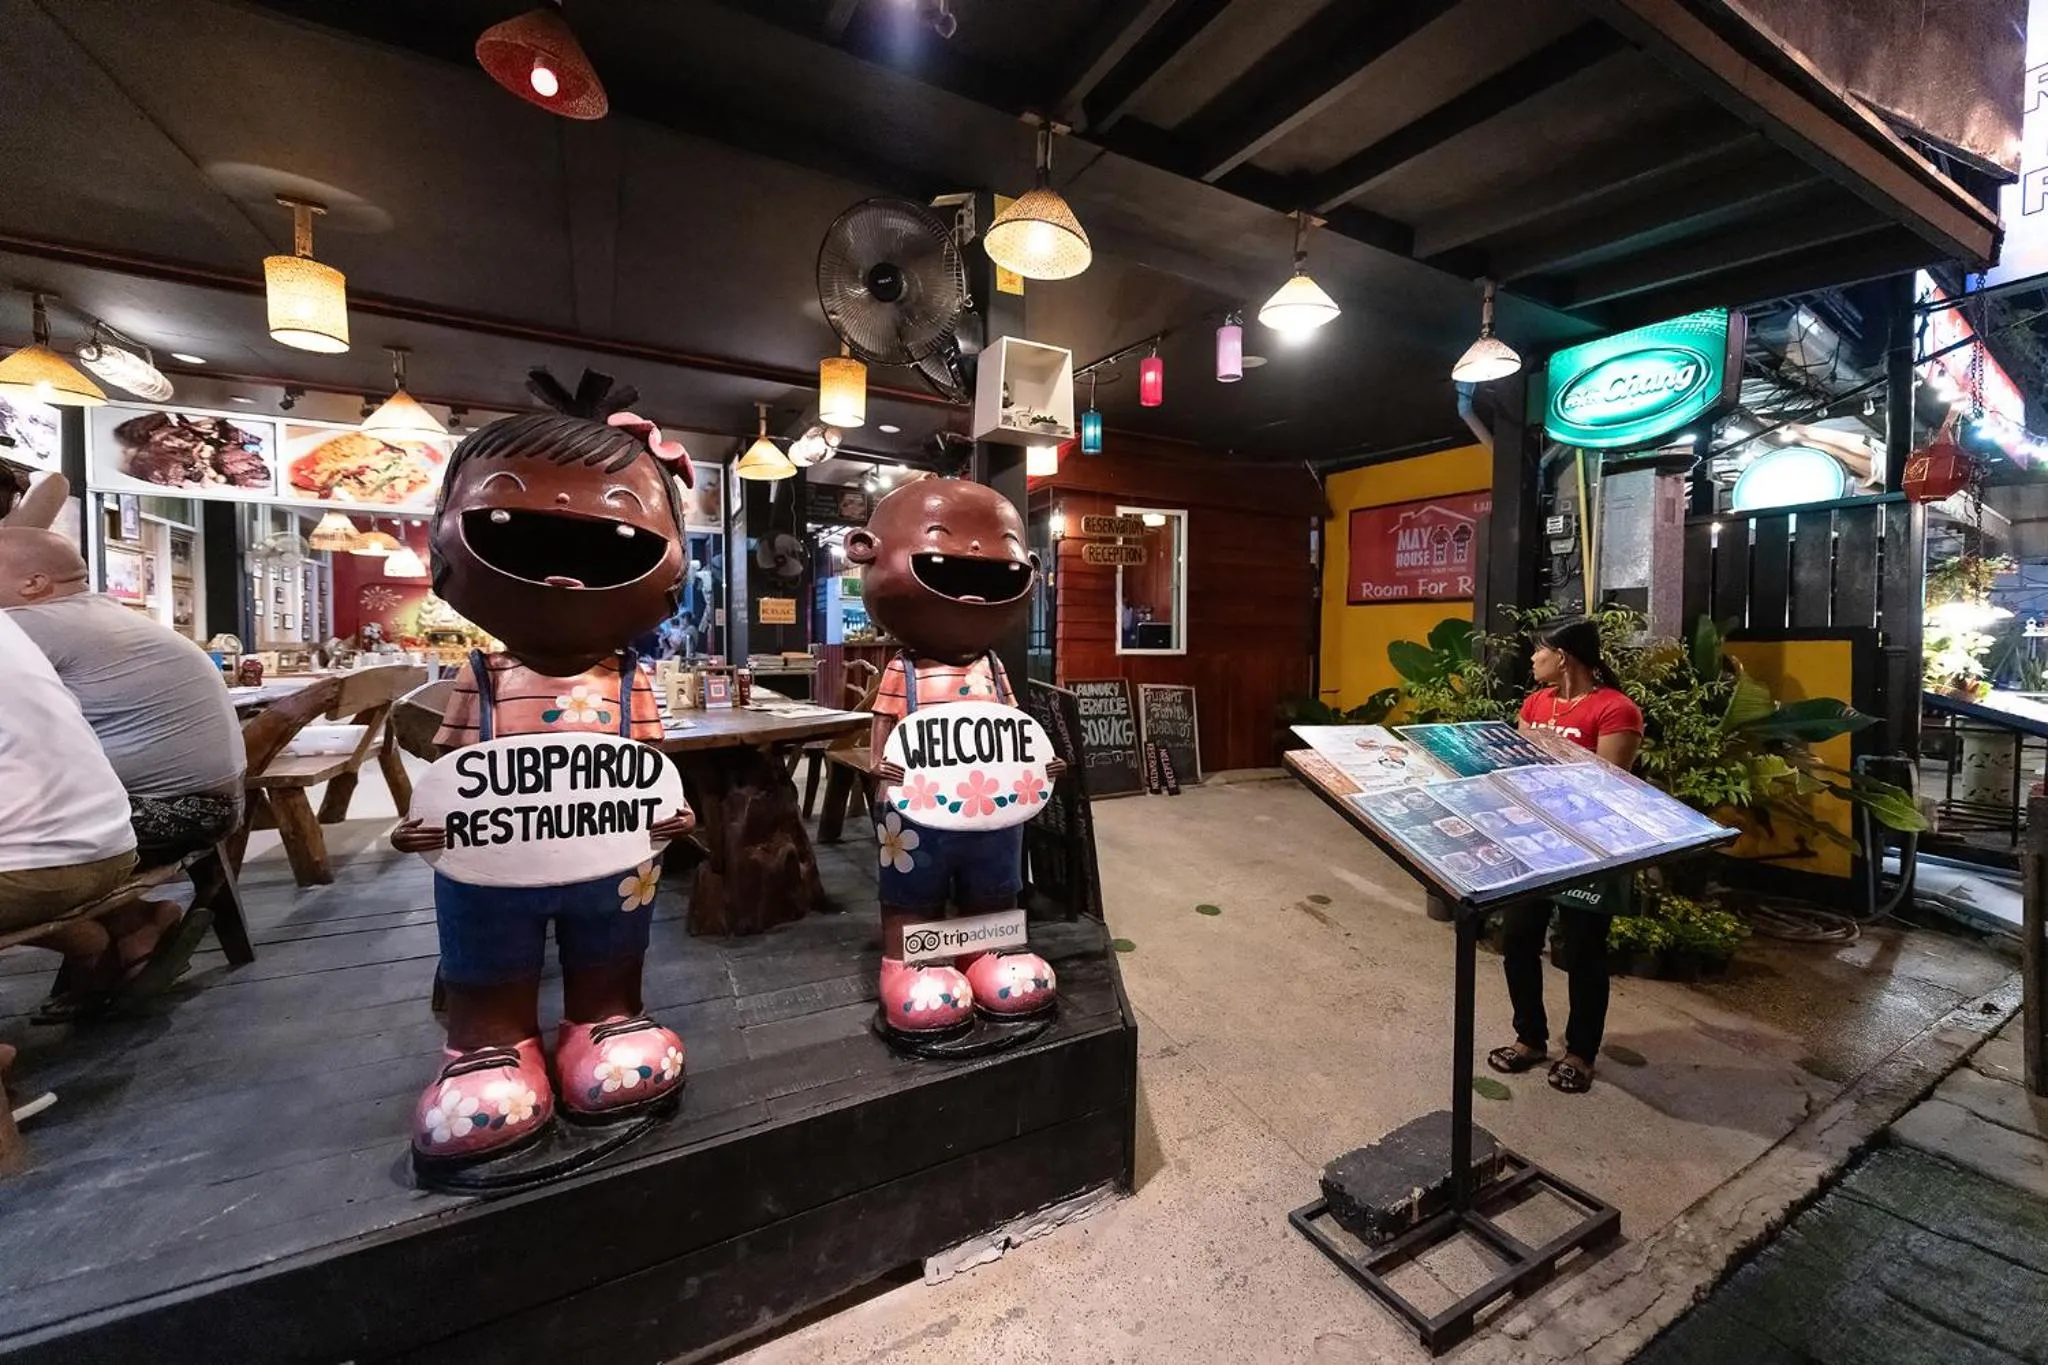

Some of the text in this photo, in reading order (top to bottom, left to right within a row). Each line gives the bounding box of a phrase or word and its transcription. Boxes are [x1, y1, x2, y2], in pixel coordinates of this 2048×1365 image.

[1603, 363, 1697, 403] Chang
[1084, 516, 1145, 535] RESERVATION
[1397, 526, 1433, 551] MAY
[1088, 546, 1144, 562] RECEPTION
[1396, 550, 1431, 569] HOUSE
[1361, 582, 1409, 598] Room
[1417, 578, 1449, 595] For
[1079, 697, 1127, 715] ERVICE
[898, 717, 1036, 769] WELCOME
[456, 744, 663, 798] SUBPAROD
[446, 797, 663, 850] RESTAURANT
[943, 923, 1020, 947] tripadvisor
